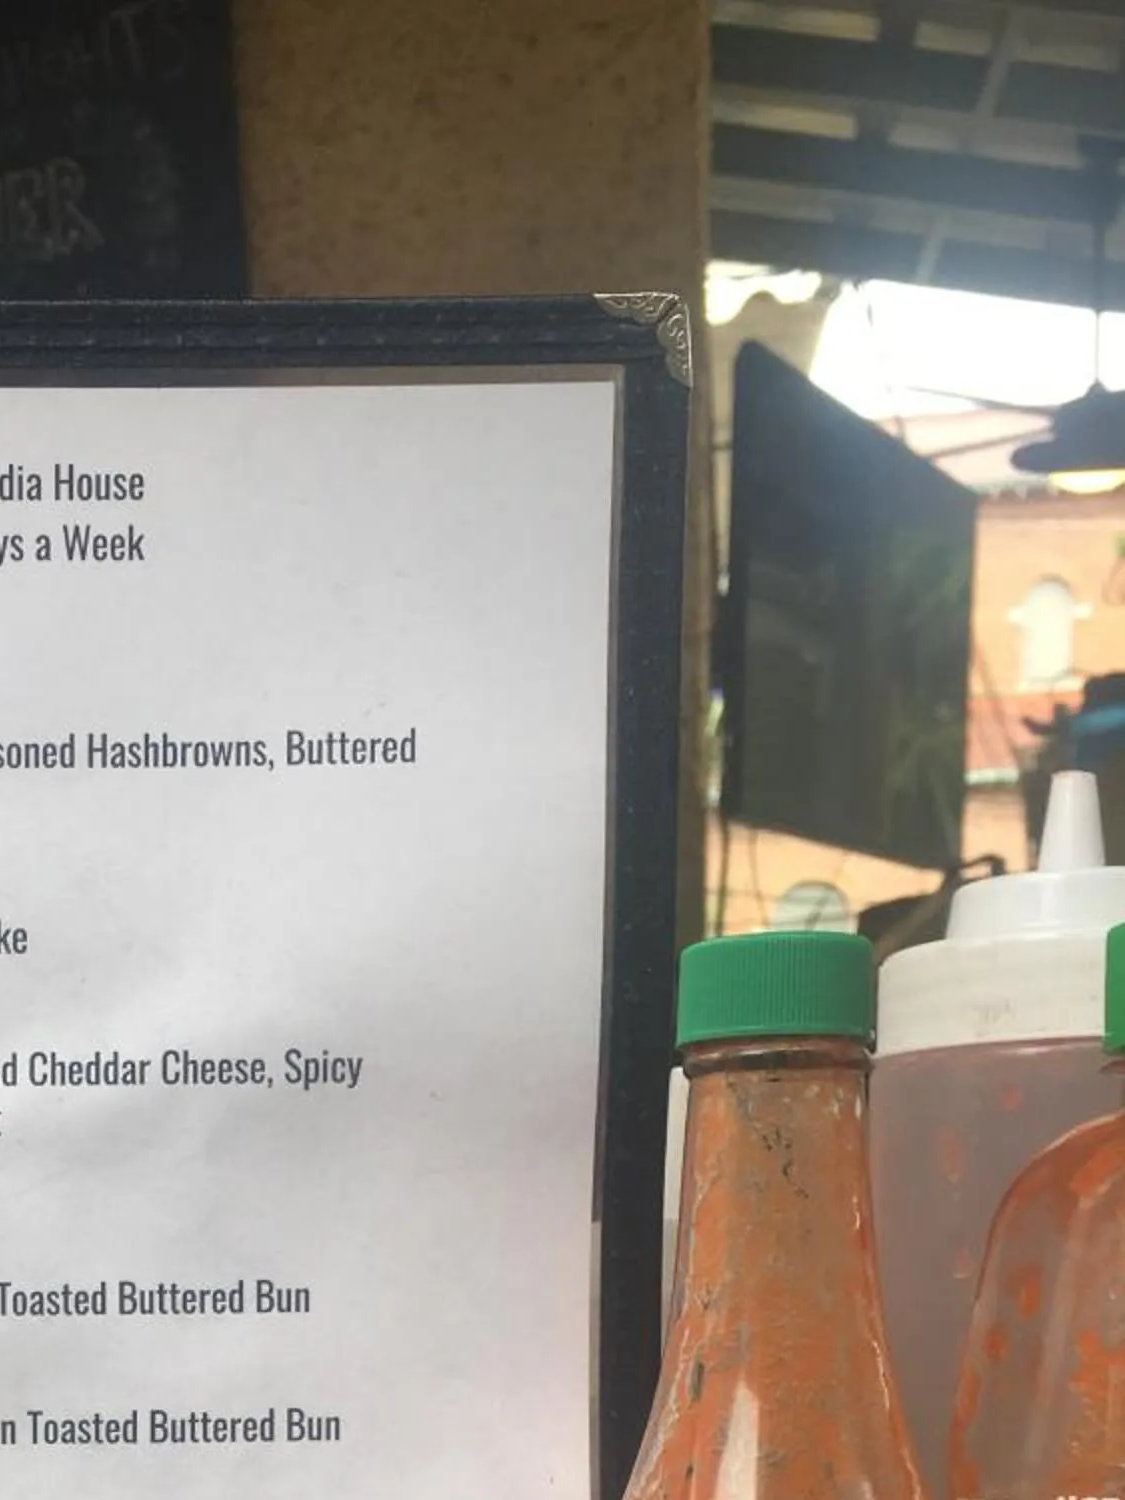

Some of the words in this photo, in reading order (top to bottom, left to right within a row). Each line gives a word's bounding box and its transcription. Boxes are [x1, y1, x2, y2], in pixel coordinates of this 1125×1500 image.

[54, 463, 145, 502] House
[34, 533, 52, 562] a
[62, 523, 146, 563] Week
[86, 731, 275, 772] Hashbrowns,
[286, 726, 417, 767] Buttered
[28, 1050, 152, 1087] Cheddar
[160, 1048, 274, 1089] Cheese,
[283, 1047, 364, 1092] Spicy
[118, 1279, 245, 1316] Buttered
[255, 1278, 311, 1314] Bun
[26, 1409, 138, 1445] Toasted
[149, 1407, 276, 1445] Buttered
[286, 1407, 341, 1443] Bun
